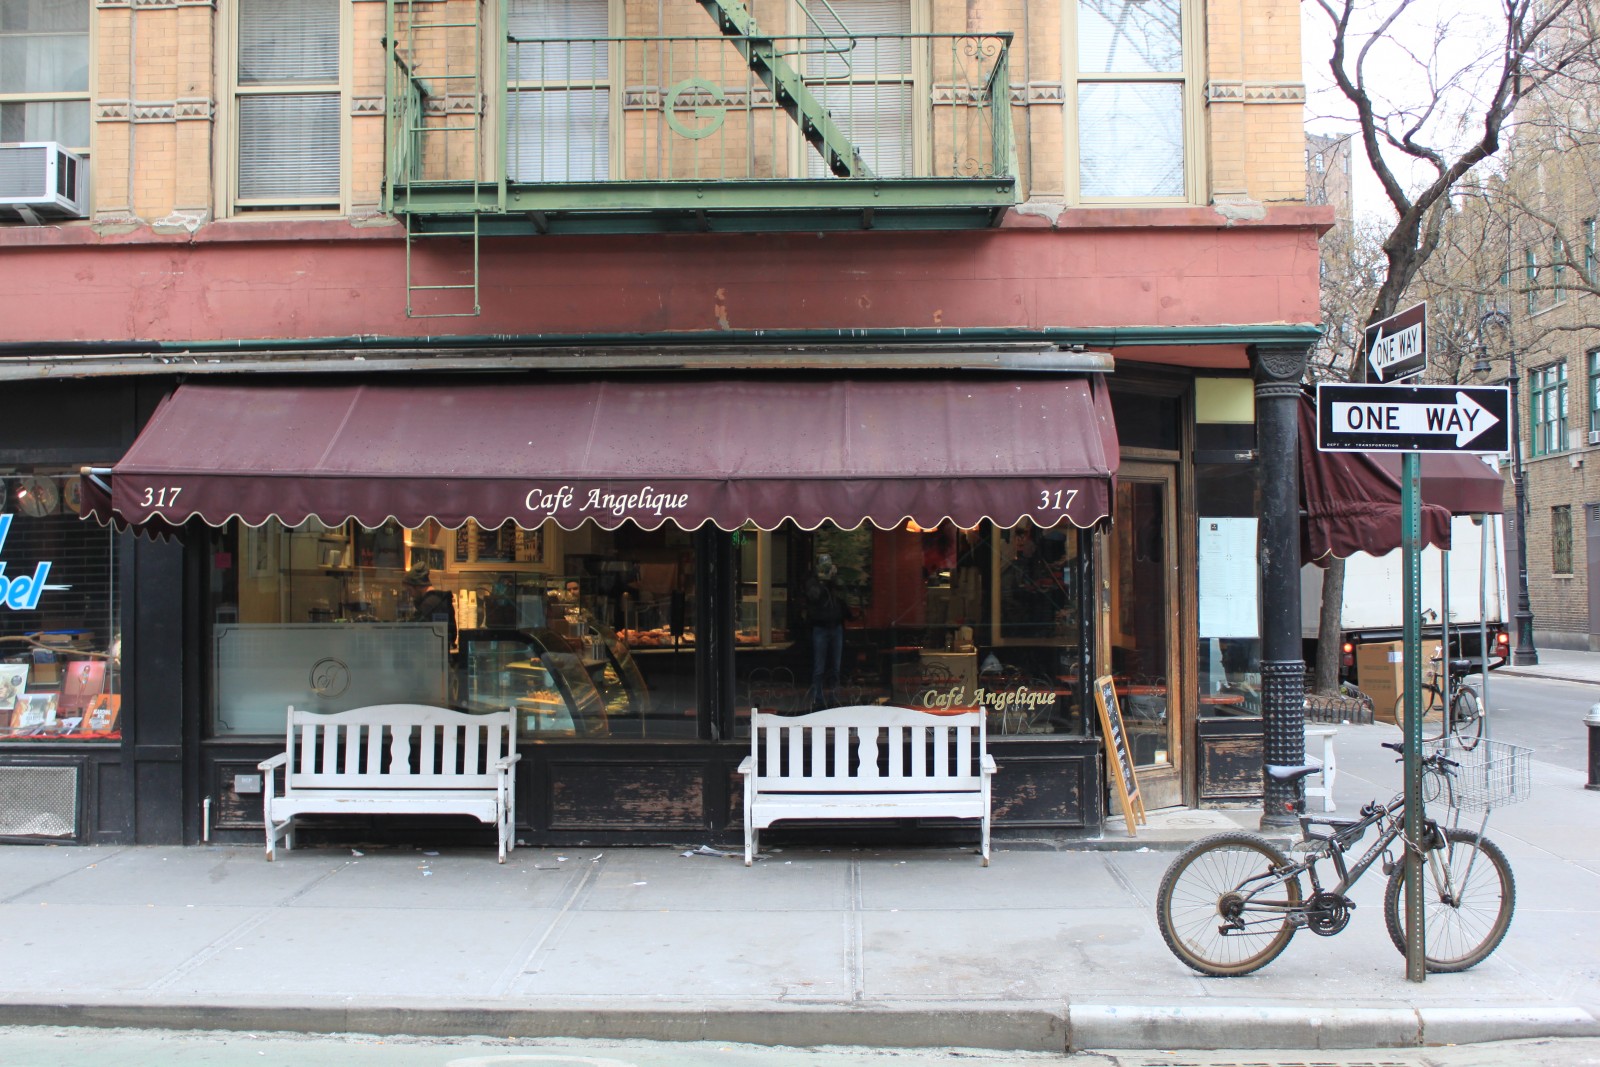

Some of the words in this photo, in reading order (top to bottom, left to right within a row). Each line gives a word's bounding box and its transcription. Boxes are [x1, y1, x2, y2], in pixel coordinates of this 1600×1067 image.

[1376, 338, 1395, 366] ONE
[1398, 327, 1418, 358] WAY
[1347, 406, 1400, 430] ONE
[1426, 407, 1480, 432] WAY
[140, 486, 182, 507] 317
[525, 485, 574, 516] Café
[579, 485, 689, 516] Angelique
[1036, 489, 1079, 510] 317
[923, 685, 965, 711] Café
[967, 685, 1056, 711] Angelique
